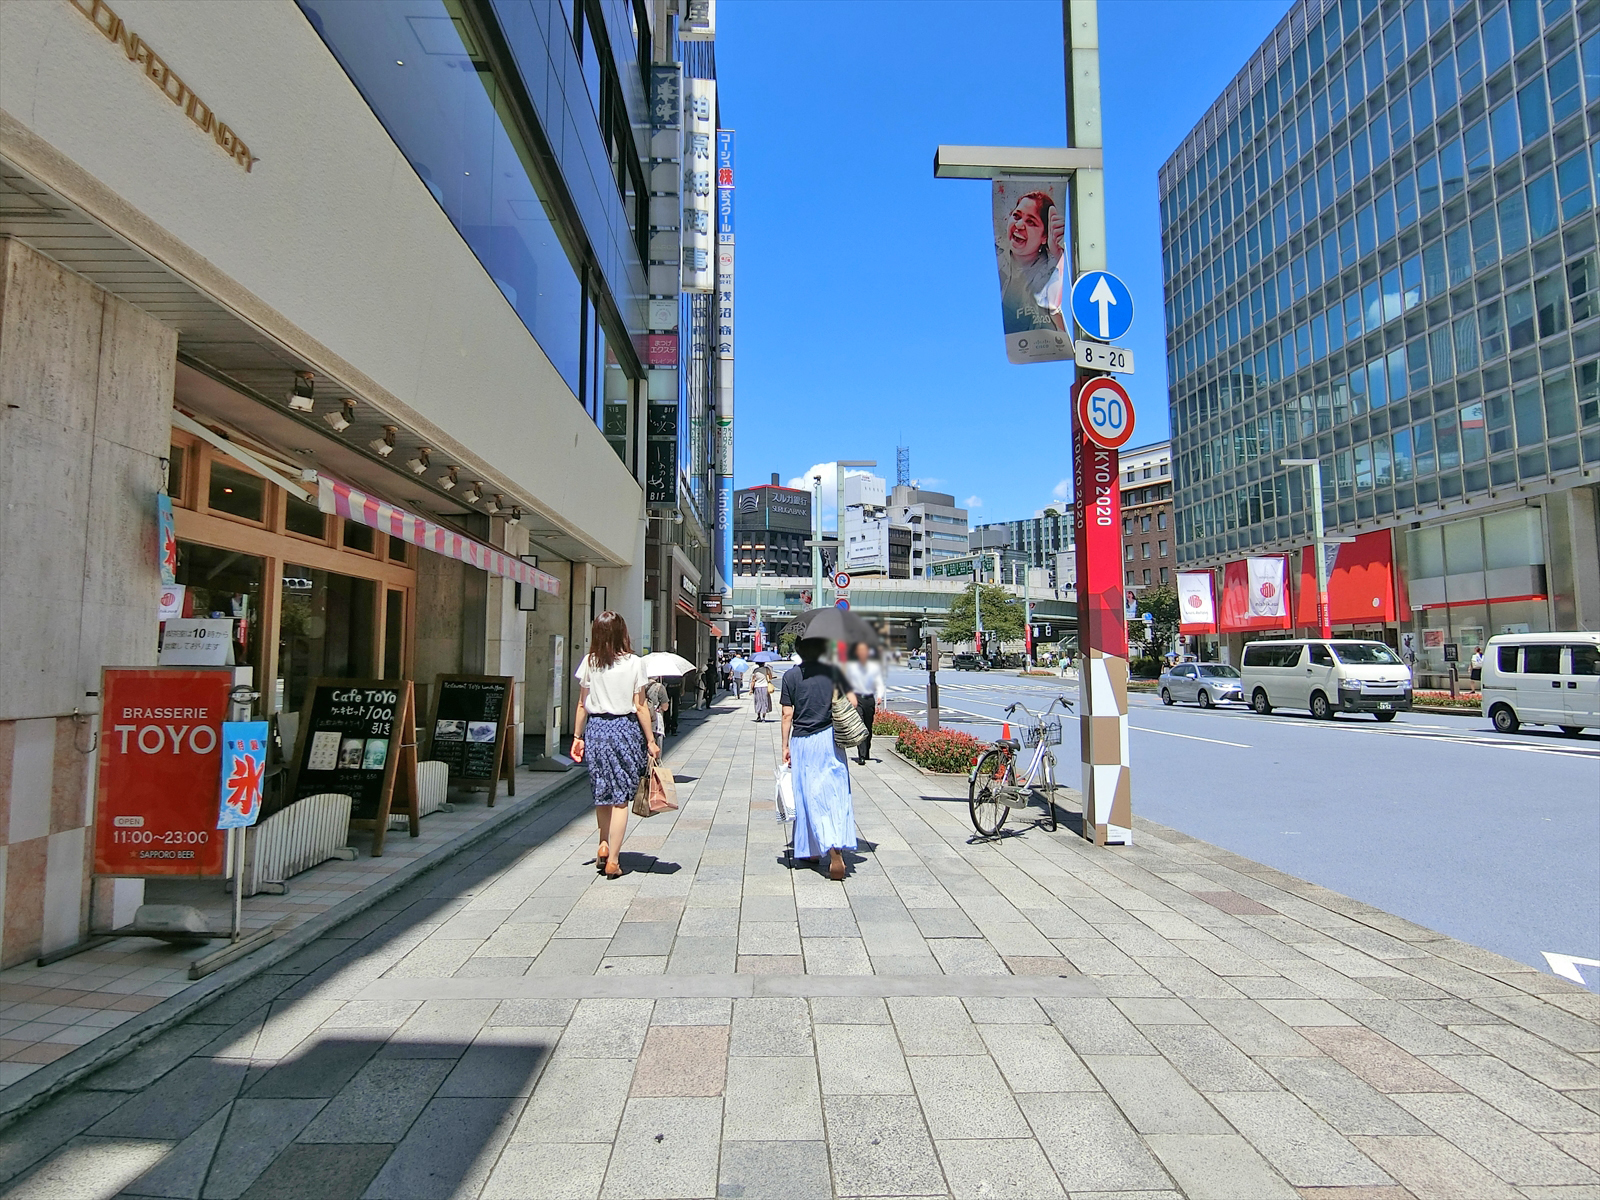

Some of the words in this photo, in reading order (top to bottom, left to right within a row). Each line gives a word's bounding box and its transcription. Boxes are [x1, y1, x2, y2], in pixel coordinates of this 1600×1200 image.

[651, 346, 676, 354] エクステ
[1092, 396, 1122, 429] 50
[1074, 432, 1083, 486] TOKYO
[718, 488, 730, 530] kinko's
[772, 492, 807, 506] スルガ銀行
[1075, 489, 1084, 529] 2020
[1095, 486, 1112, 526] 2020
[332, 689, 362, 703] Cafe
[122, 708, 208, 719] BRASSERIE
[331, 705, 365, 716] ケーキセット
[114, 724, 217, 755] TOYO
[371, 722, 390, 736] 引き
[226, 753, 265, 815] 氷
[139, 850, 176, 859] SAPPORO
[177, 850, 195, 859] BEER
